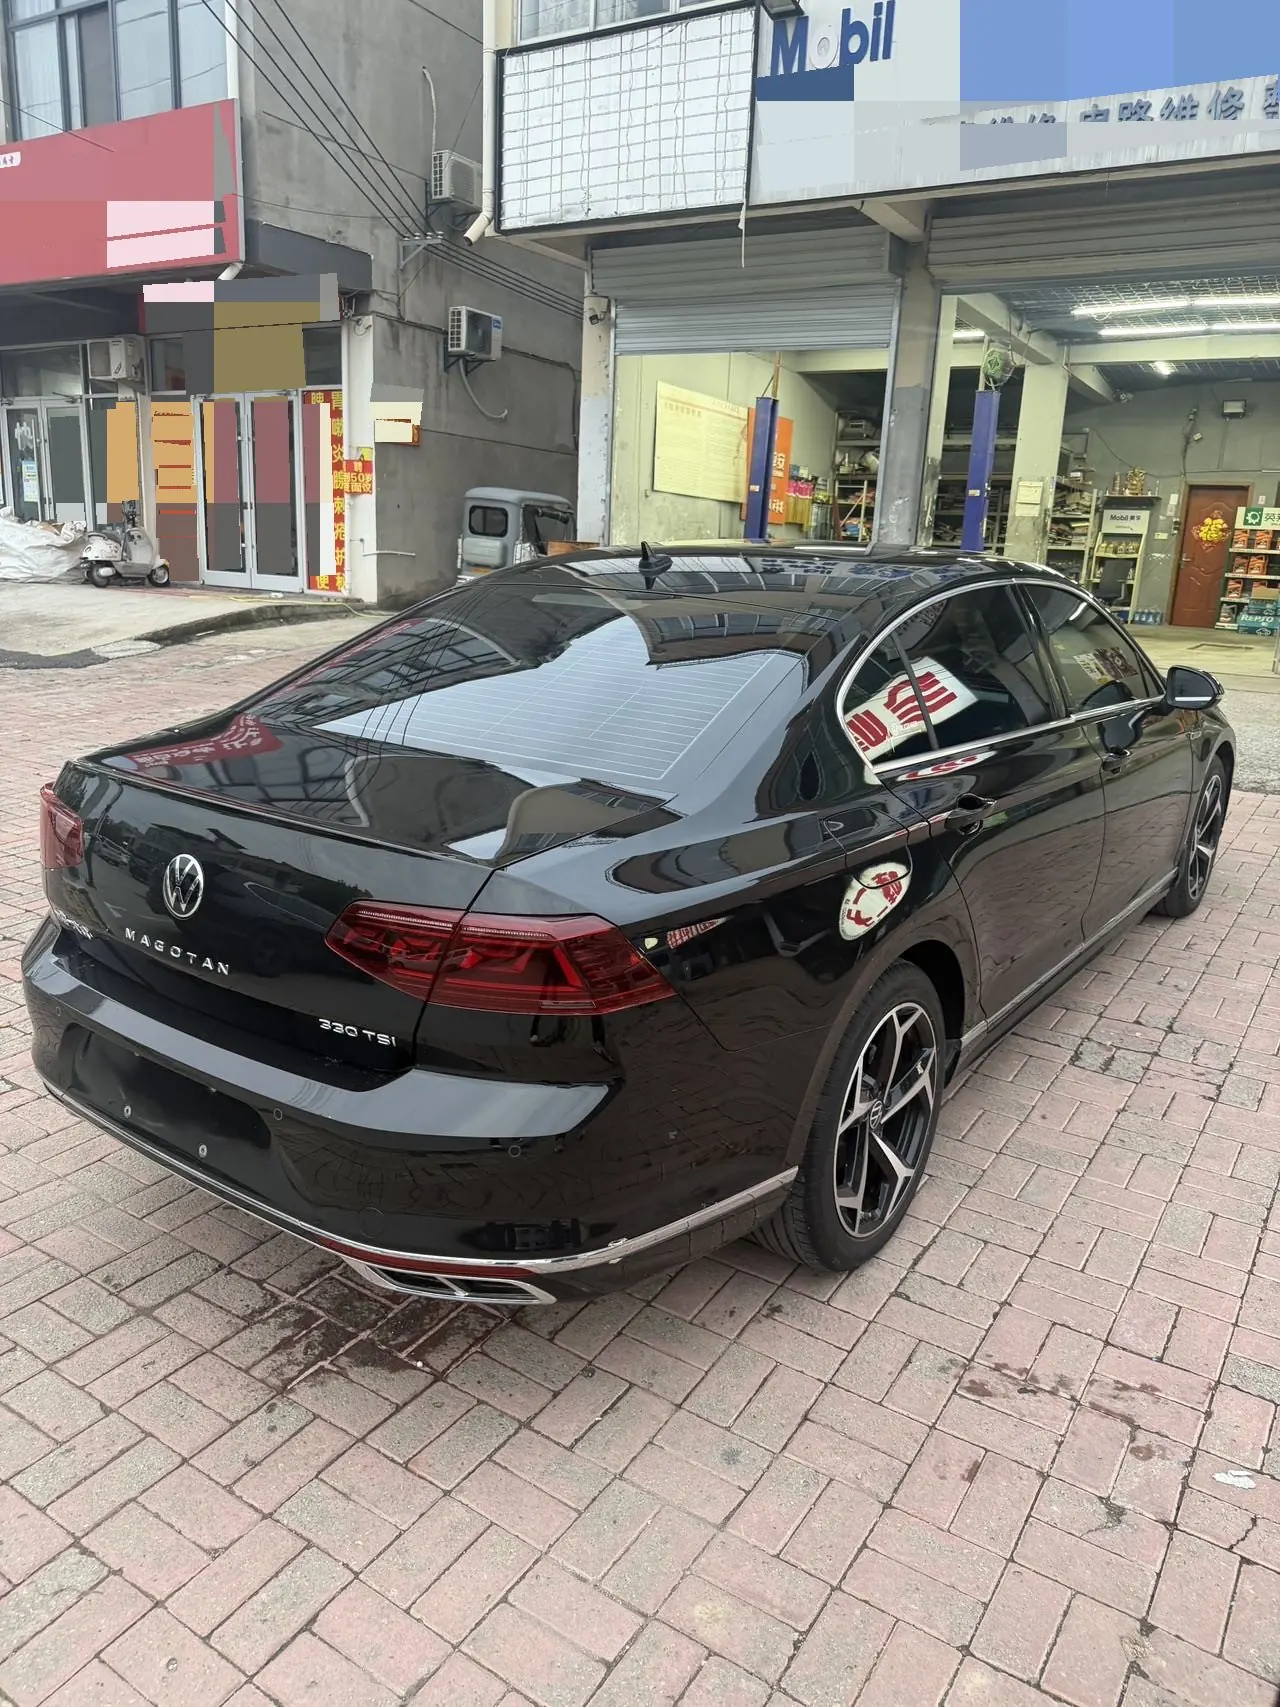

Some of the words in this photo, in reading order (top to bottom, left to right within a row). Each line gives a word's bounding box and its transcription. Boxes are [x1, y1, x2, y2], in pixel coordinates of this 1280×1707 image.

[770, 0, 896, 77] Mobil
[125, 927, 229, 976] MAGOTAN
[318, 1018, 358, 1037] 330
[362, 1029, 396, 1047] TSI
